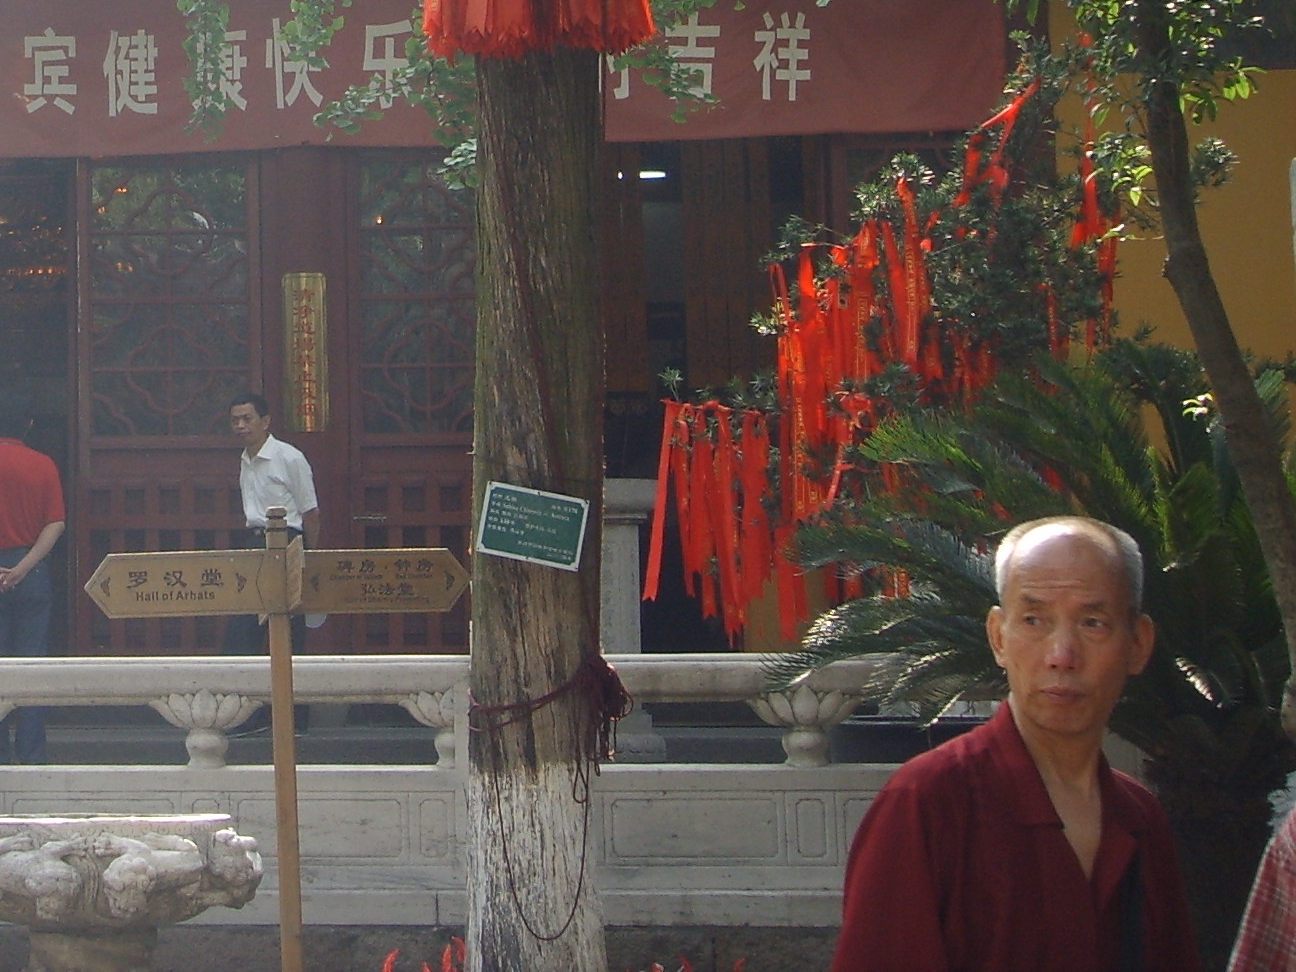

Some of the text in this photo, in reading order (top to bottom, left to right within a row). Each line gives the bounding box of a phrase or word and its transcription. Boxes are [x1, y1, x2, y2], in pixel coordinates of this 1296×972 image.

[125, 567, 225, 589] 罗汉堂
[136, 590, 216, 602] Hall of Arhats
